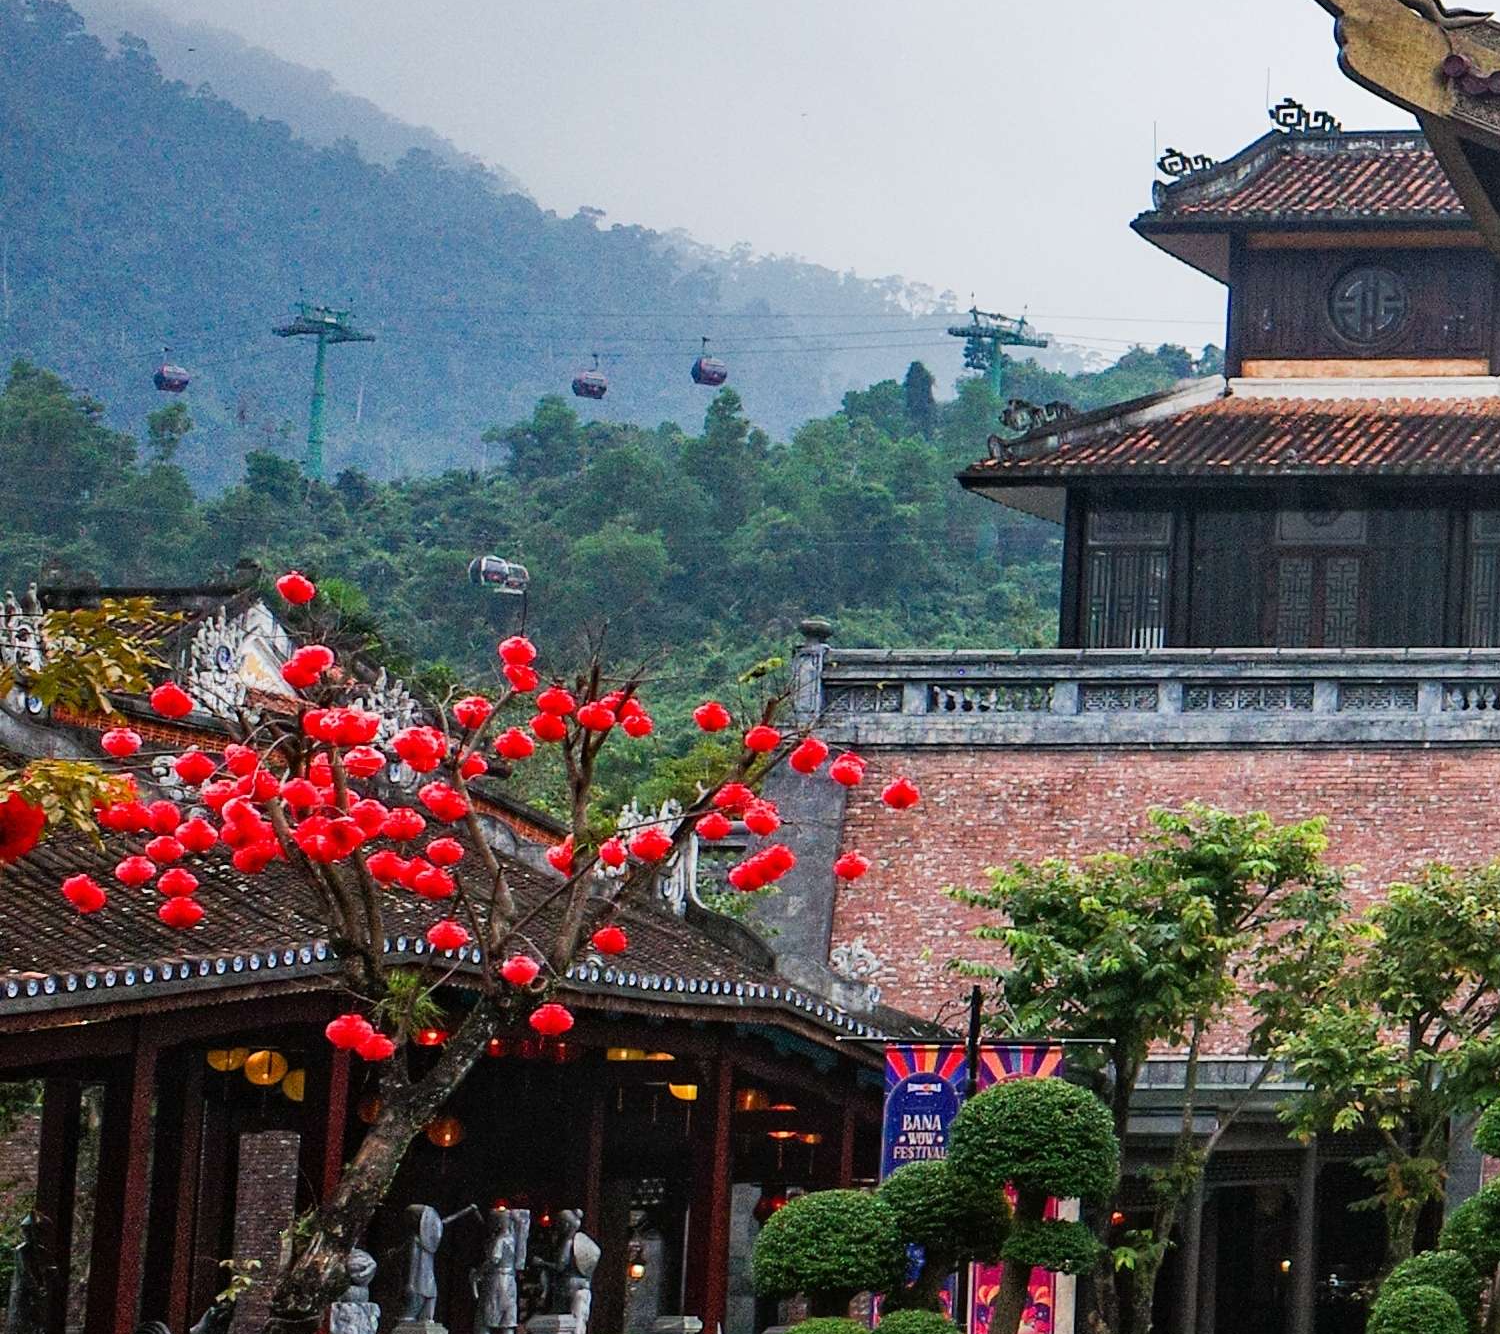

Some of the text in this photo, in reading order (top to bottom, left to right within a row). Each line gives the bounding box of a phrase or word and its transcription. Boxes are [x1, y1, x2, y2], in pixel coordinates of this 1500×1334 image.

[903, 1115, 941, 1131] BANA
[908, 1133, 936, 1145] WOW
[893, 1146, 947, 1159] FESTIVAL
